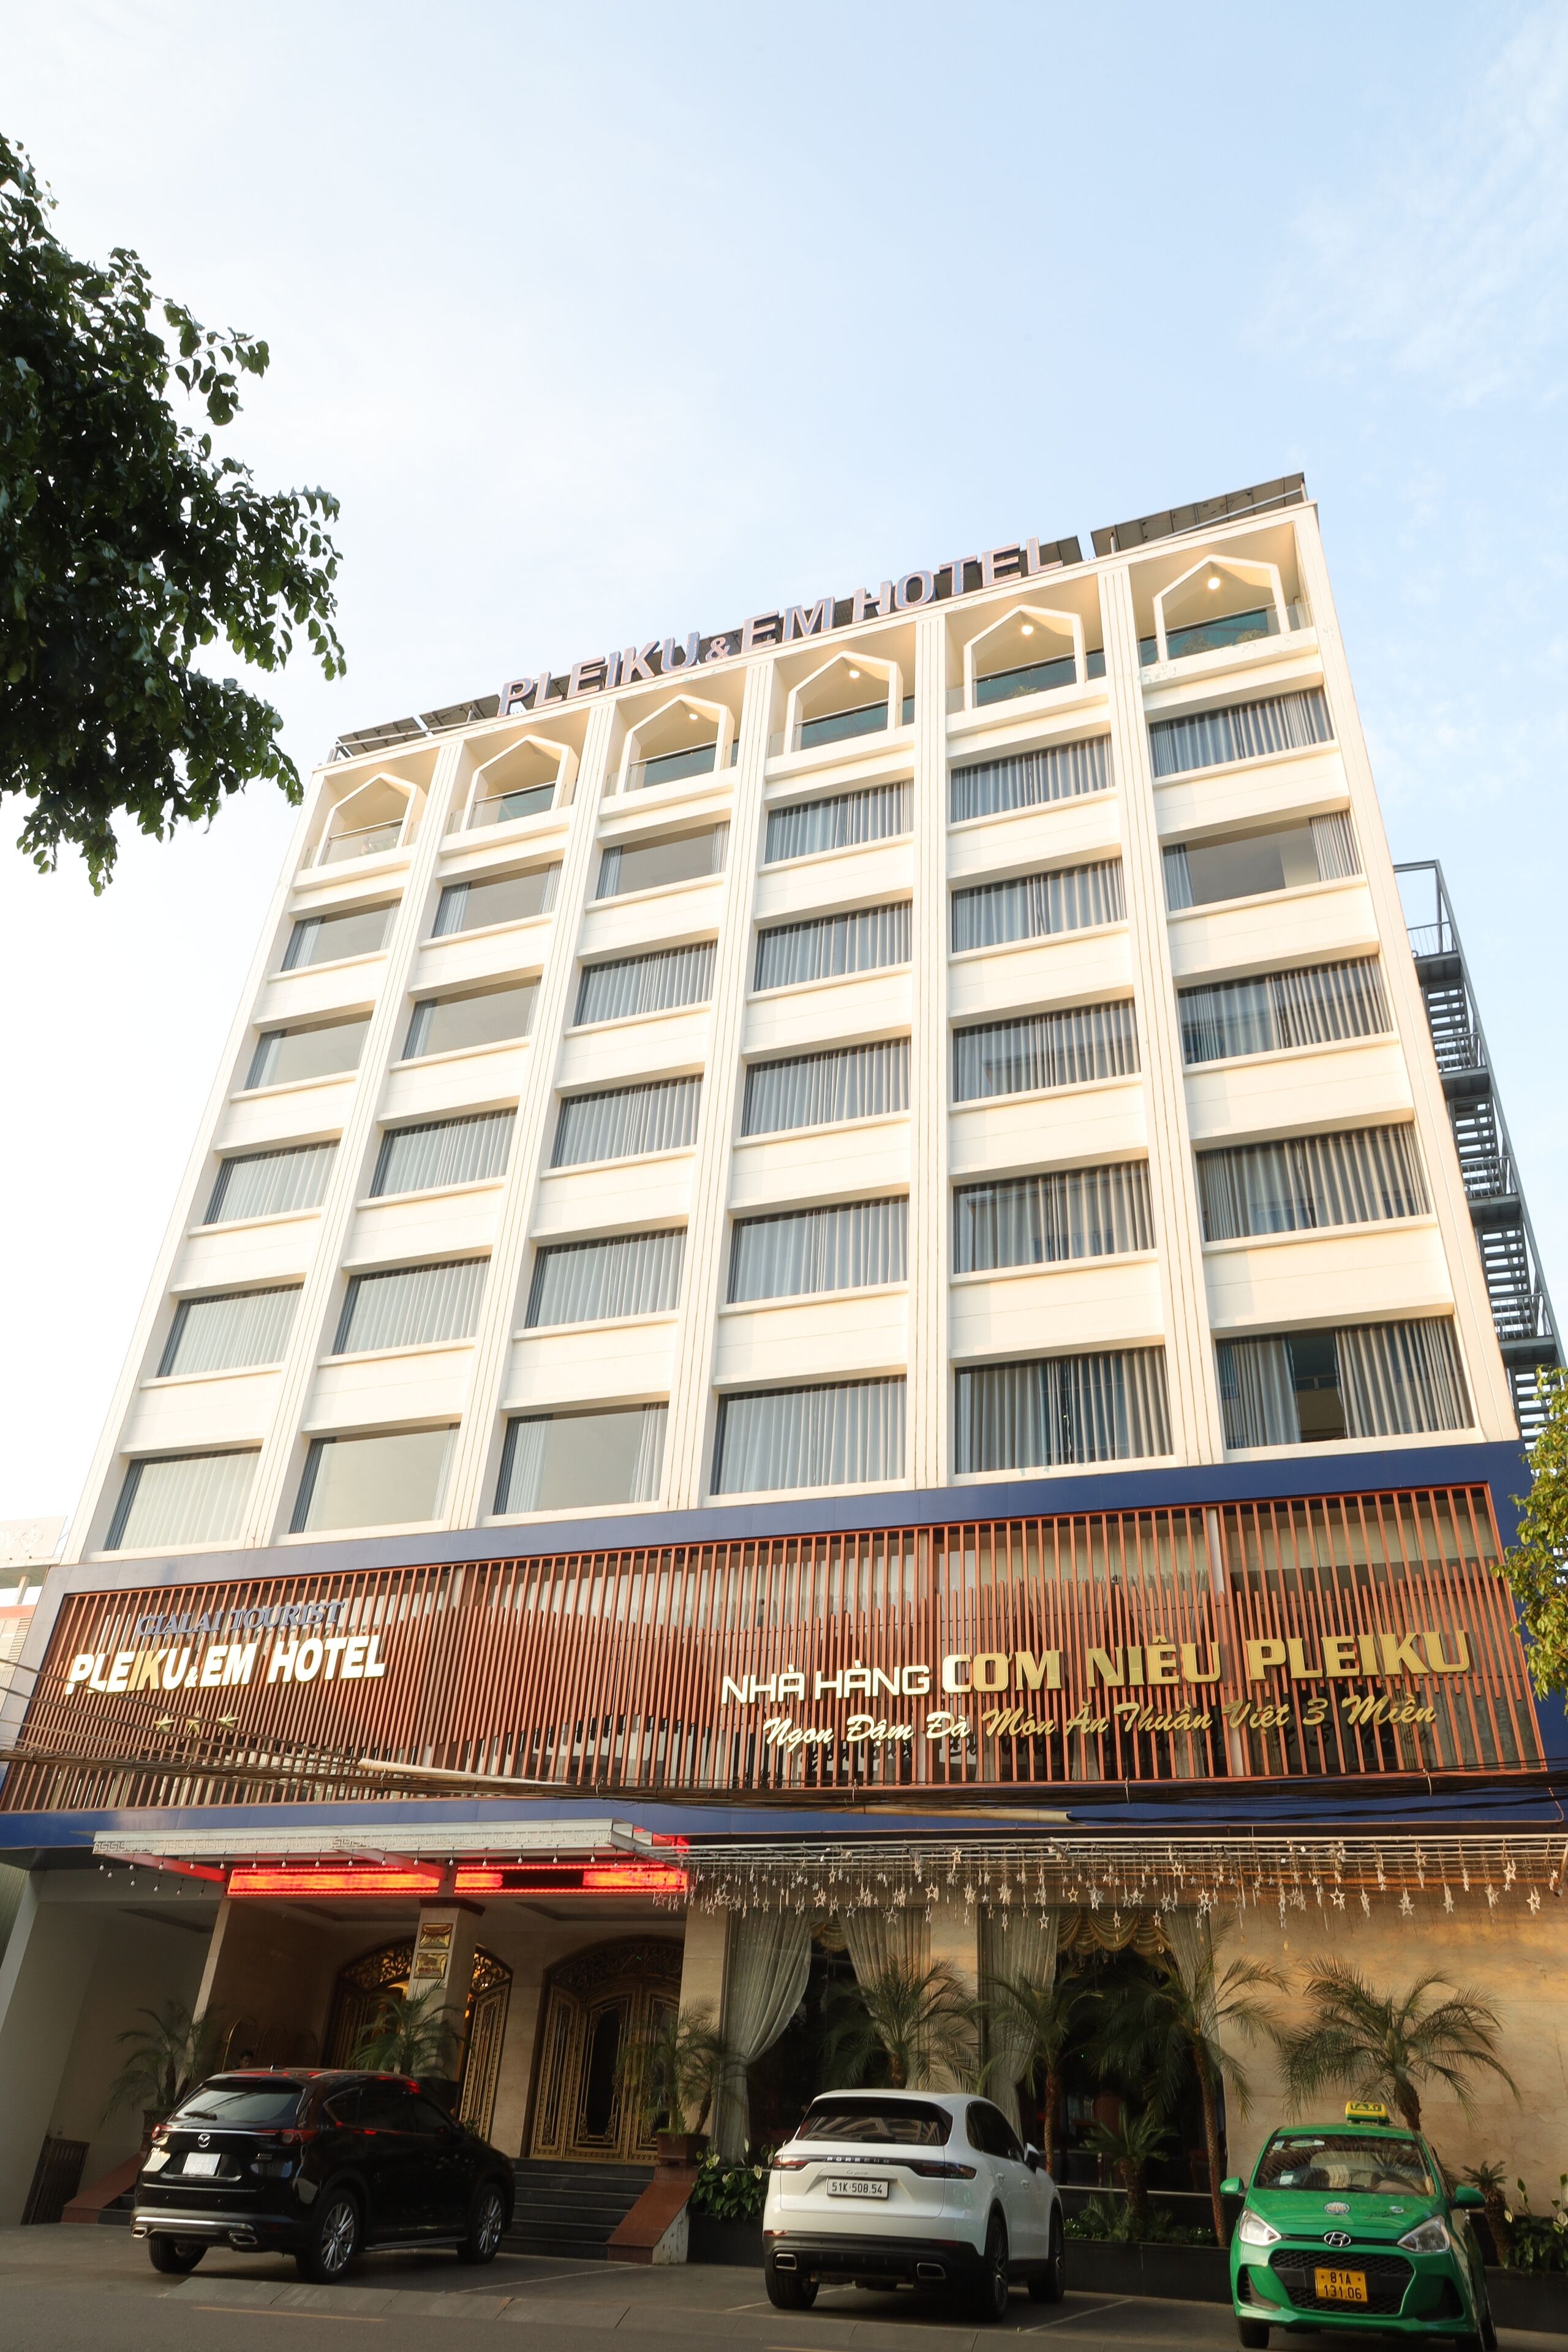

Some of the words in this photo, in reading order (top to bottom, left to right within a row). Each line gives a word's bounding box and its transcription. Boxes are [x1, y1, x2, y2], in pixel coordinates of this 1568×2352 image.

[497, 632, 699, 717] PLEIKU
[742, 596, 835, 653] EM
[851, 537, 1063, 624] HOTEL
[230, 1601, 345, 1630] TOURIST
[268, 1635, 386, 1683] HOTEL
[722, 1664, 805, 1705] NHÀ
[815, 1660, 930, 1700] HÀNG
[942, 1650, 1062, 1694] CƠM
[1088, 1635, 1221, 1687] NIÊU
[1246, 1630, 1470, 1681] PLEIKU
[763, 1716, 834, 1753] Ngon
[846, 1714, 914, 1747] Đậm
[925, 1711, 971, 1740] Đà
[981, 1707, 1056, 1738] Món
[1065, 1700, 1109, 1737] Ăn
[1113, 1701, 1213, 1732] Thuần
[1222, 1699, 1289, 1735] Việt
[1302, 1697, 1329, 1725] 3
[1341, 1692, 1437, 1725] Miền
[1351, 2102, 1380, 2111] TAXI
[1324, 2285, 1362, 2299] 131.06
[1330, 2272, 1352, 2285] 81A
